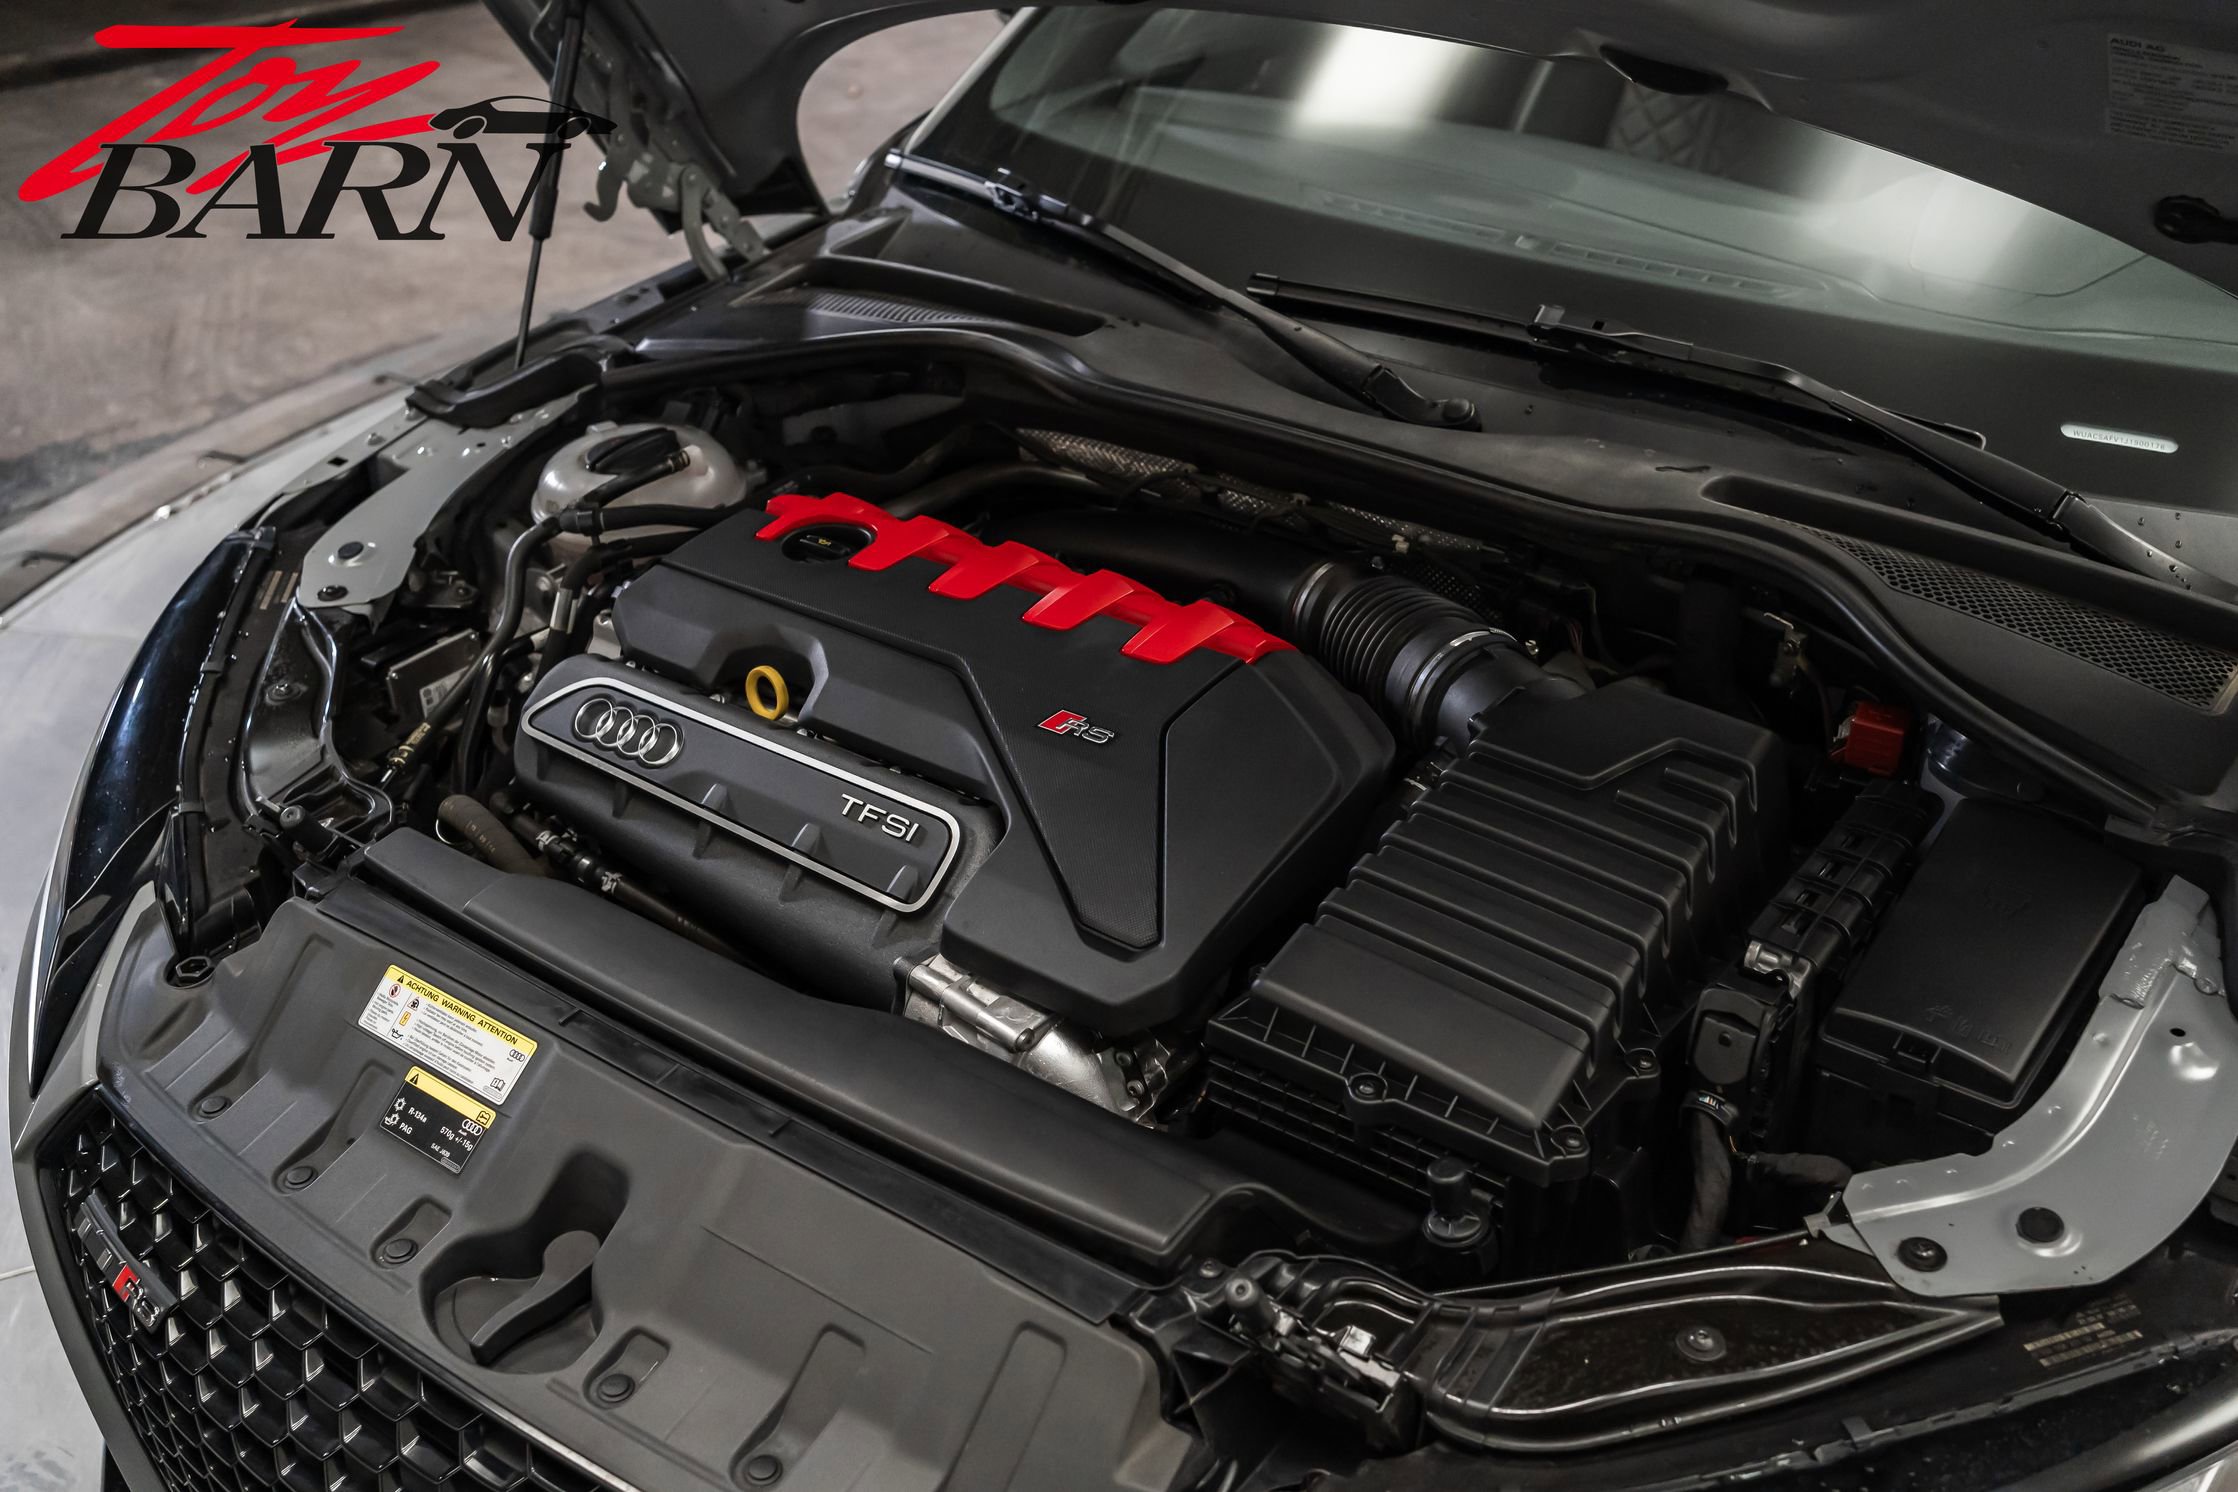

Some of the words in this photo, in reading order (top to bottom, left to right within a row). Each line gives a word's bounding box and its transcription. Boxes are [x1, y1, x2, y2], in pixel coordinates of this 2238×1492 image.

[1046, 712, 1115, 744] RS
[841, 793, 920, 842] TFSI
[405, 980, 440, 1002] ACHTUNG
[441, 998, 476, 1022] WARNING
[477, 1019, 518, 1046] ATTENTION
[398, 1122, 413, 1135] PAG
[440, 1126, 455, 1141] 570g
[115, 1268, 161, 1328] RS
